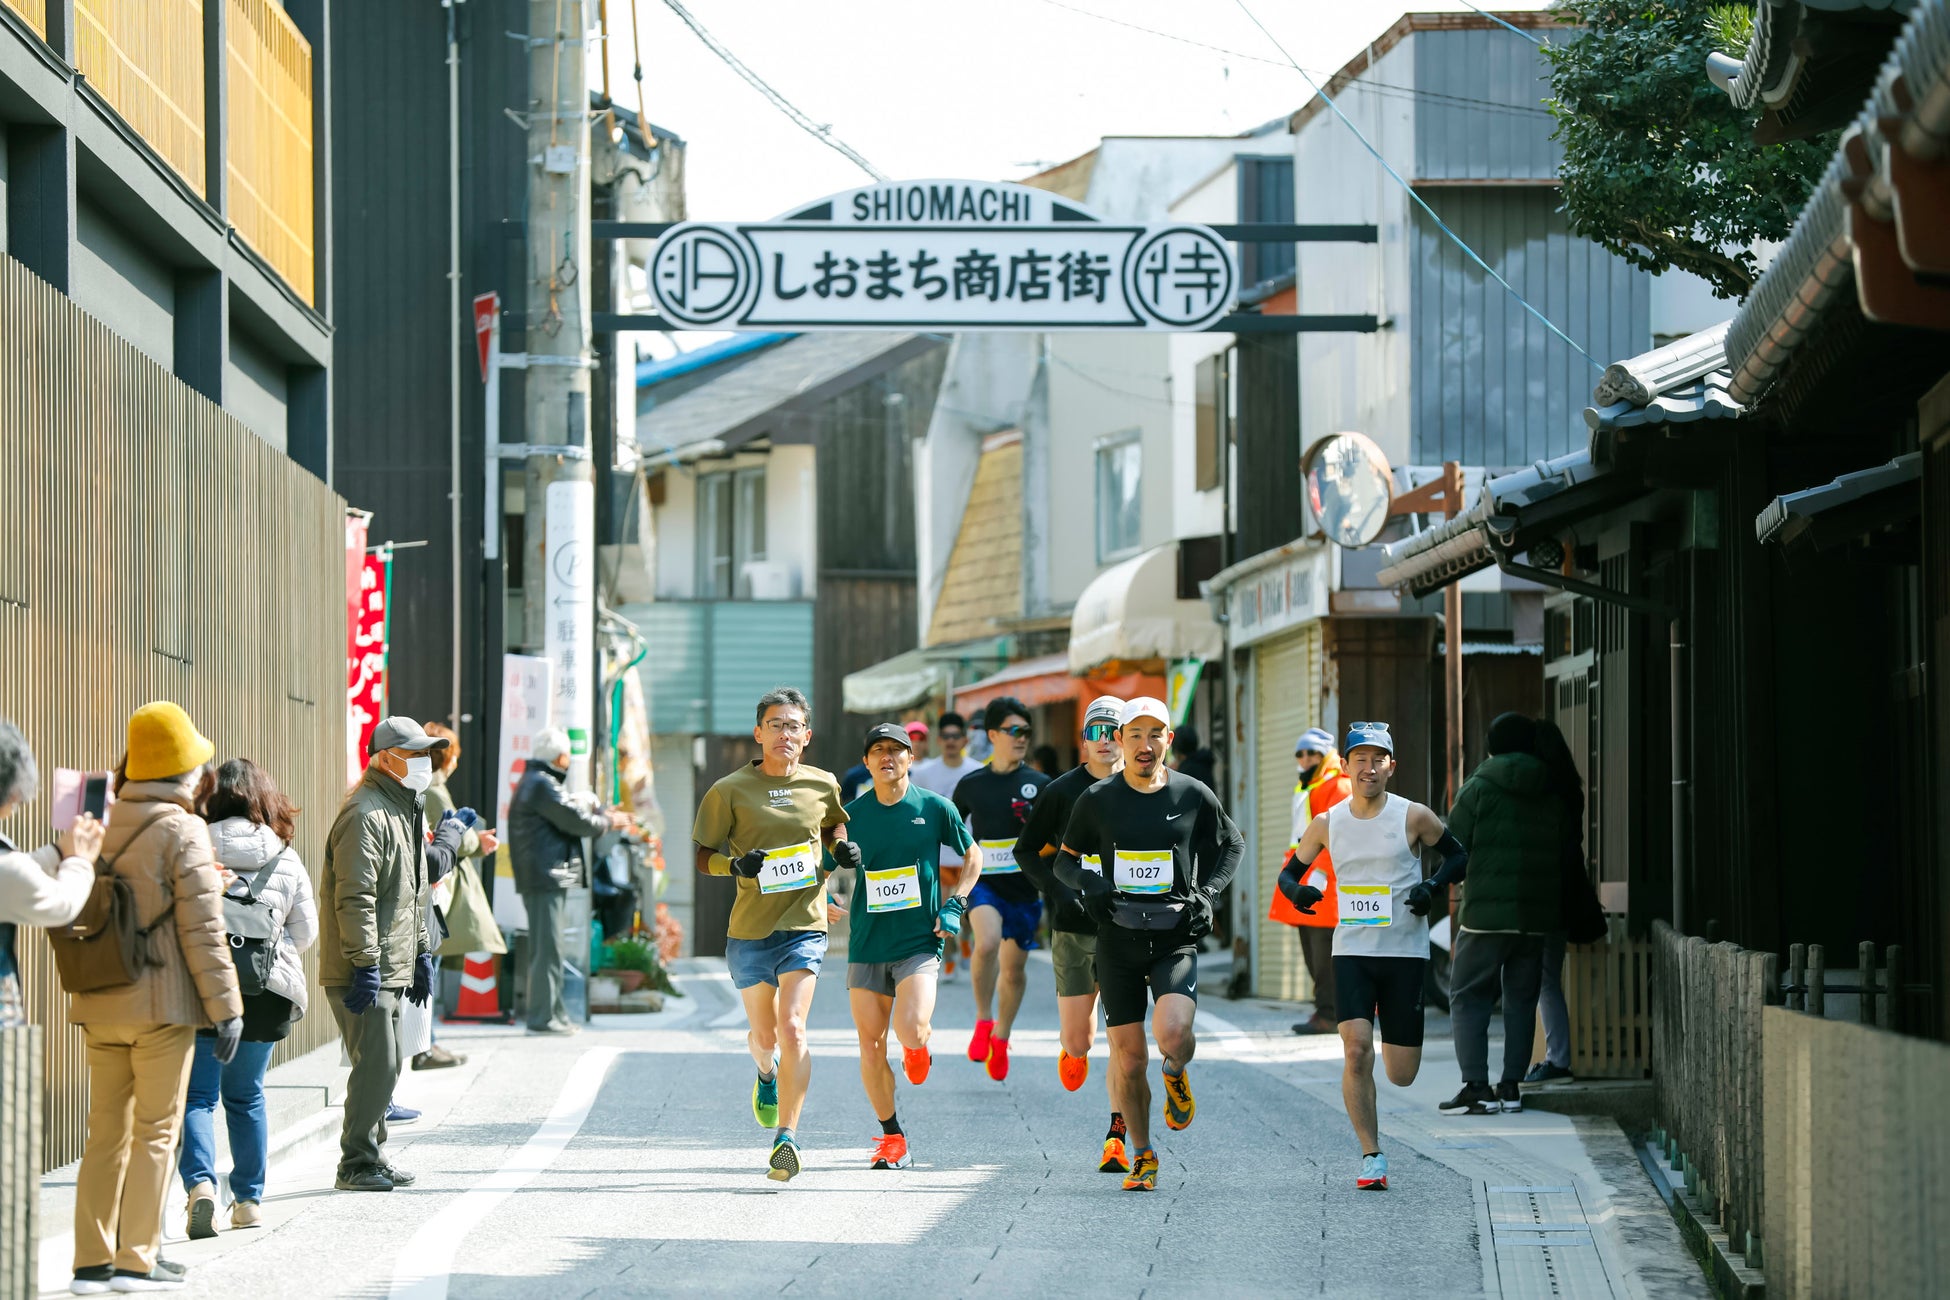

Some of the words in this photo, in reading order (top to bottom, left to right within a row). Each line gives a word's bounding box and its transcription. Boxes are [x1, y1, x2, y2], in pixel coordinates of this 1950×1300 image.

[853, 186, 1030, 221] SHIOMACHI
[774, 249, 1111, 303] しおまち商店街
[556, 619, 577, 700] 駐車場
[768, 789, 792, 798] TBSM
[772, 861, 805, 877] 1018
[1128, 867, 1160, 879] 1027
[875, 883, 906, 898] 1067
[1350, 900, 1380, 912] 1016
